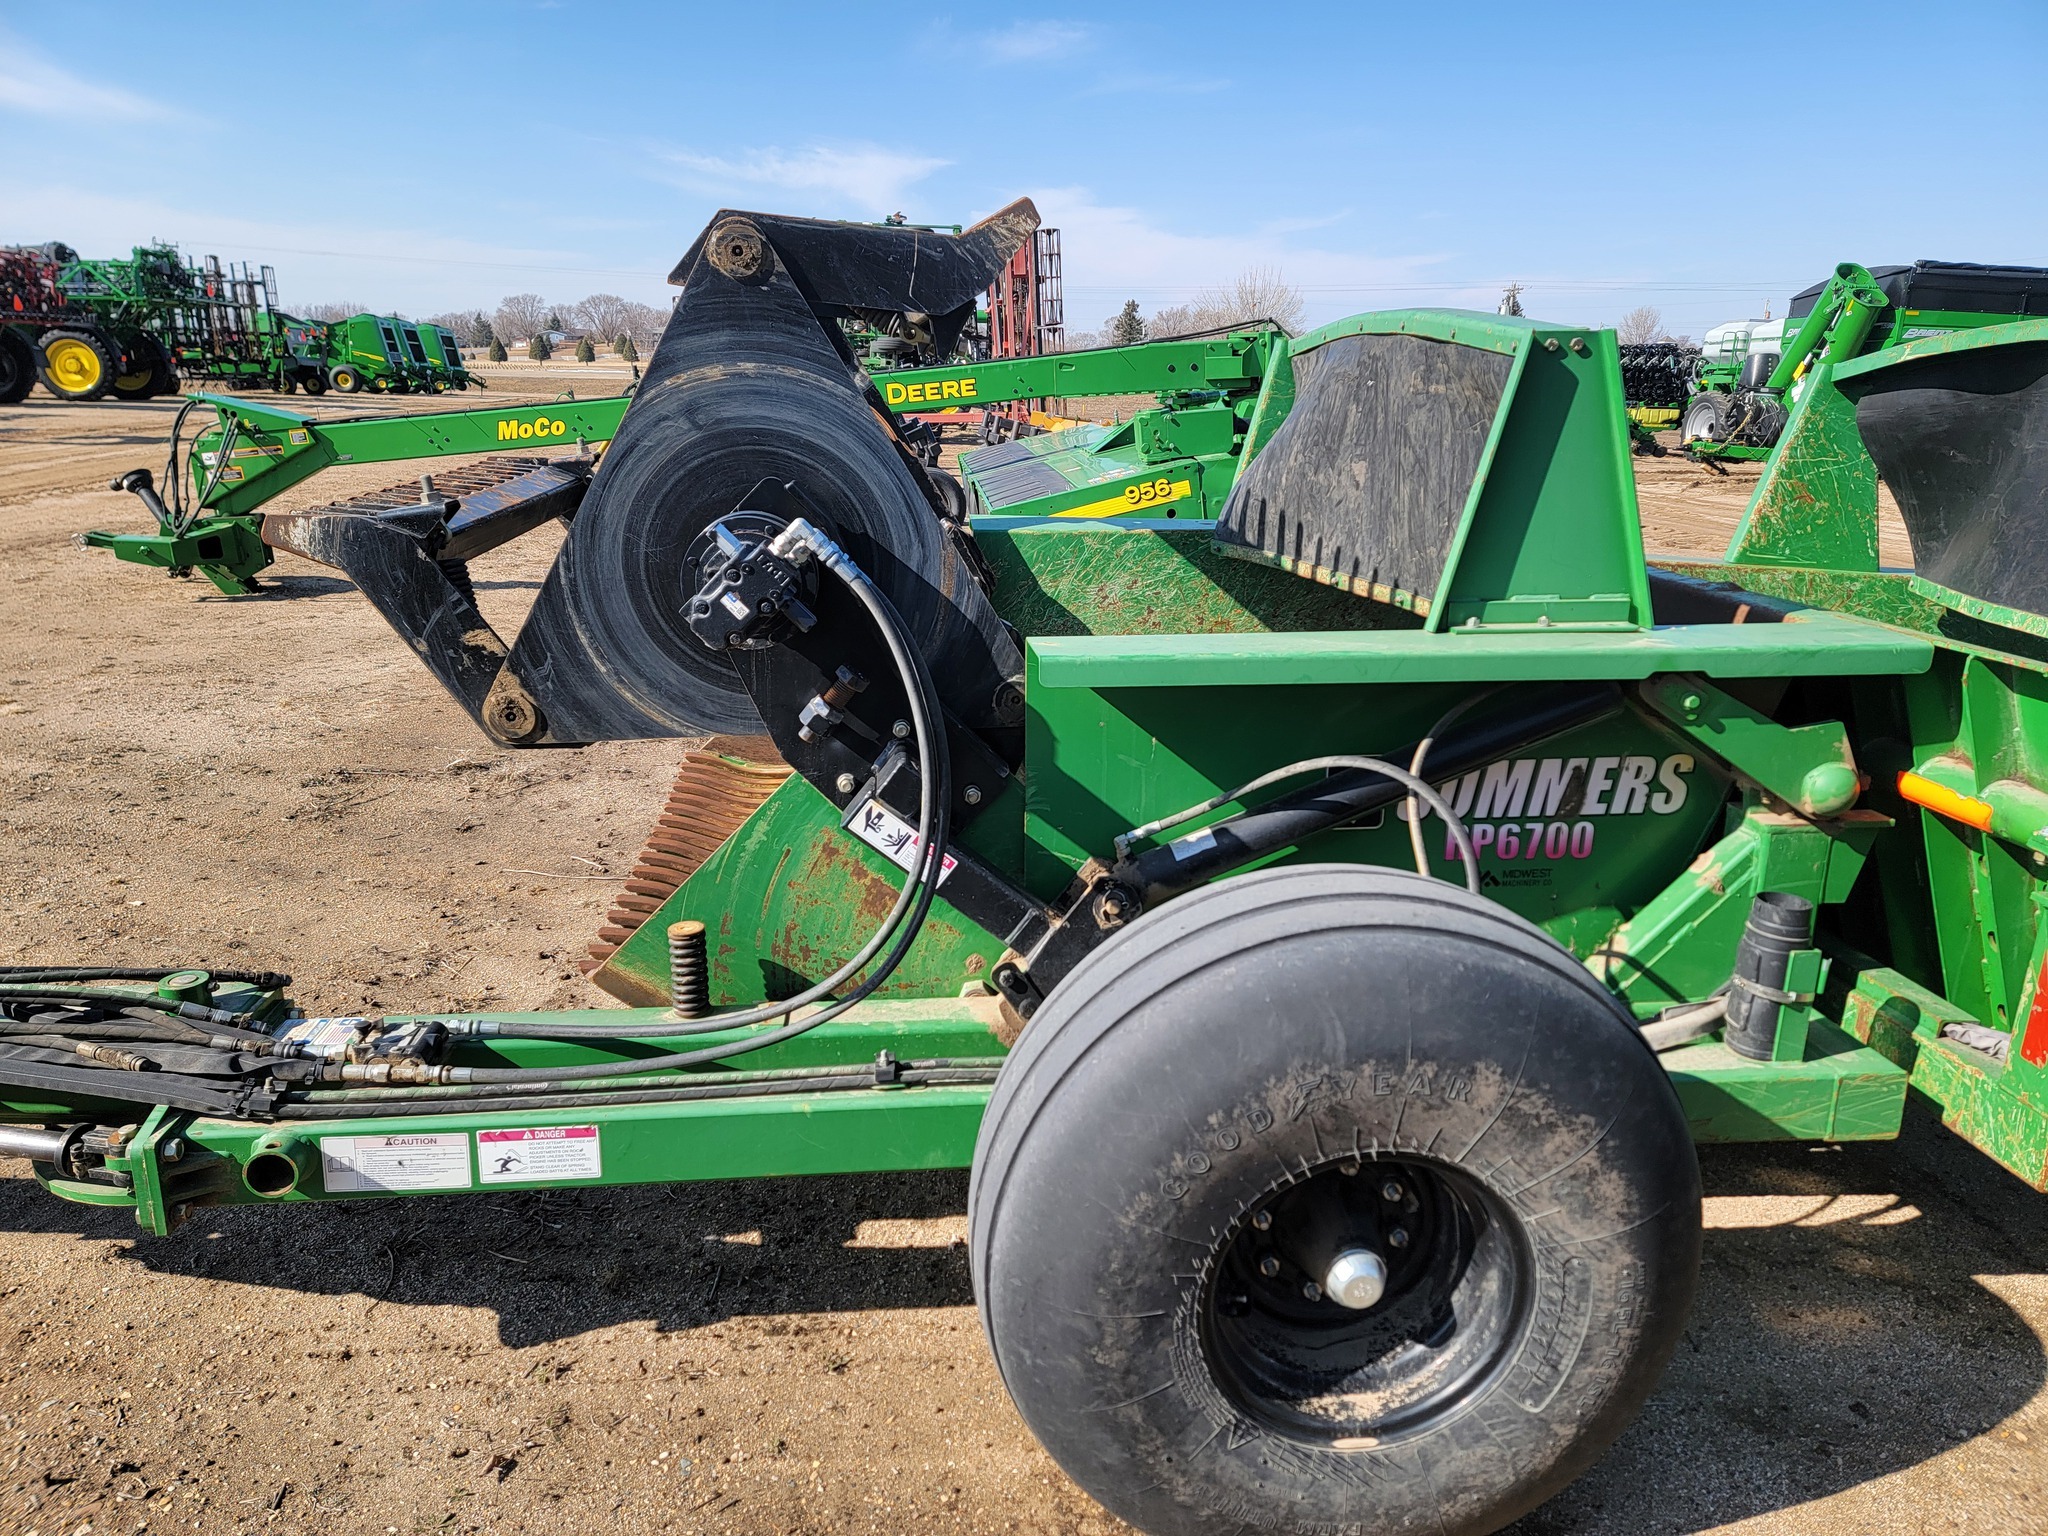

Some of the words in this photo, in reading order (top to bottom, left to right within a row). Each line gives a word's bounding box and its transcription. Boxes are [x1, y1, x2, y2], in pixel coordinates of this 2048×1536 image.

[885, 378, 978, 405] DEERE
[497, 416, 567, 441] MoCo
[1124, 478, 1172, 504] 956
[1397, 754, 1696, 824] UMMERS
[1502, 868, 1553, 879] MIDWEST
[1502, 879, 1541, 888] MACHINERY
[1543, 879, 1553, 887] CO
[393, 1137, 438, 1146] CAUTION
[534, 1130, 566, 1139] DANGER
